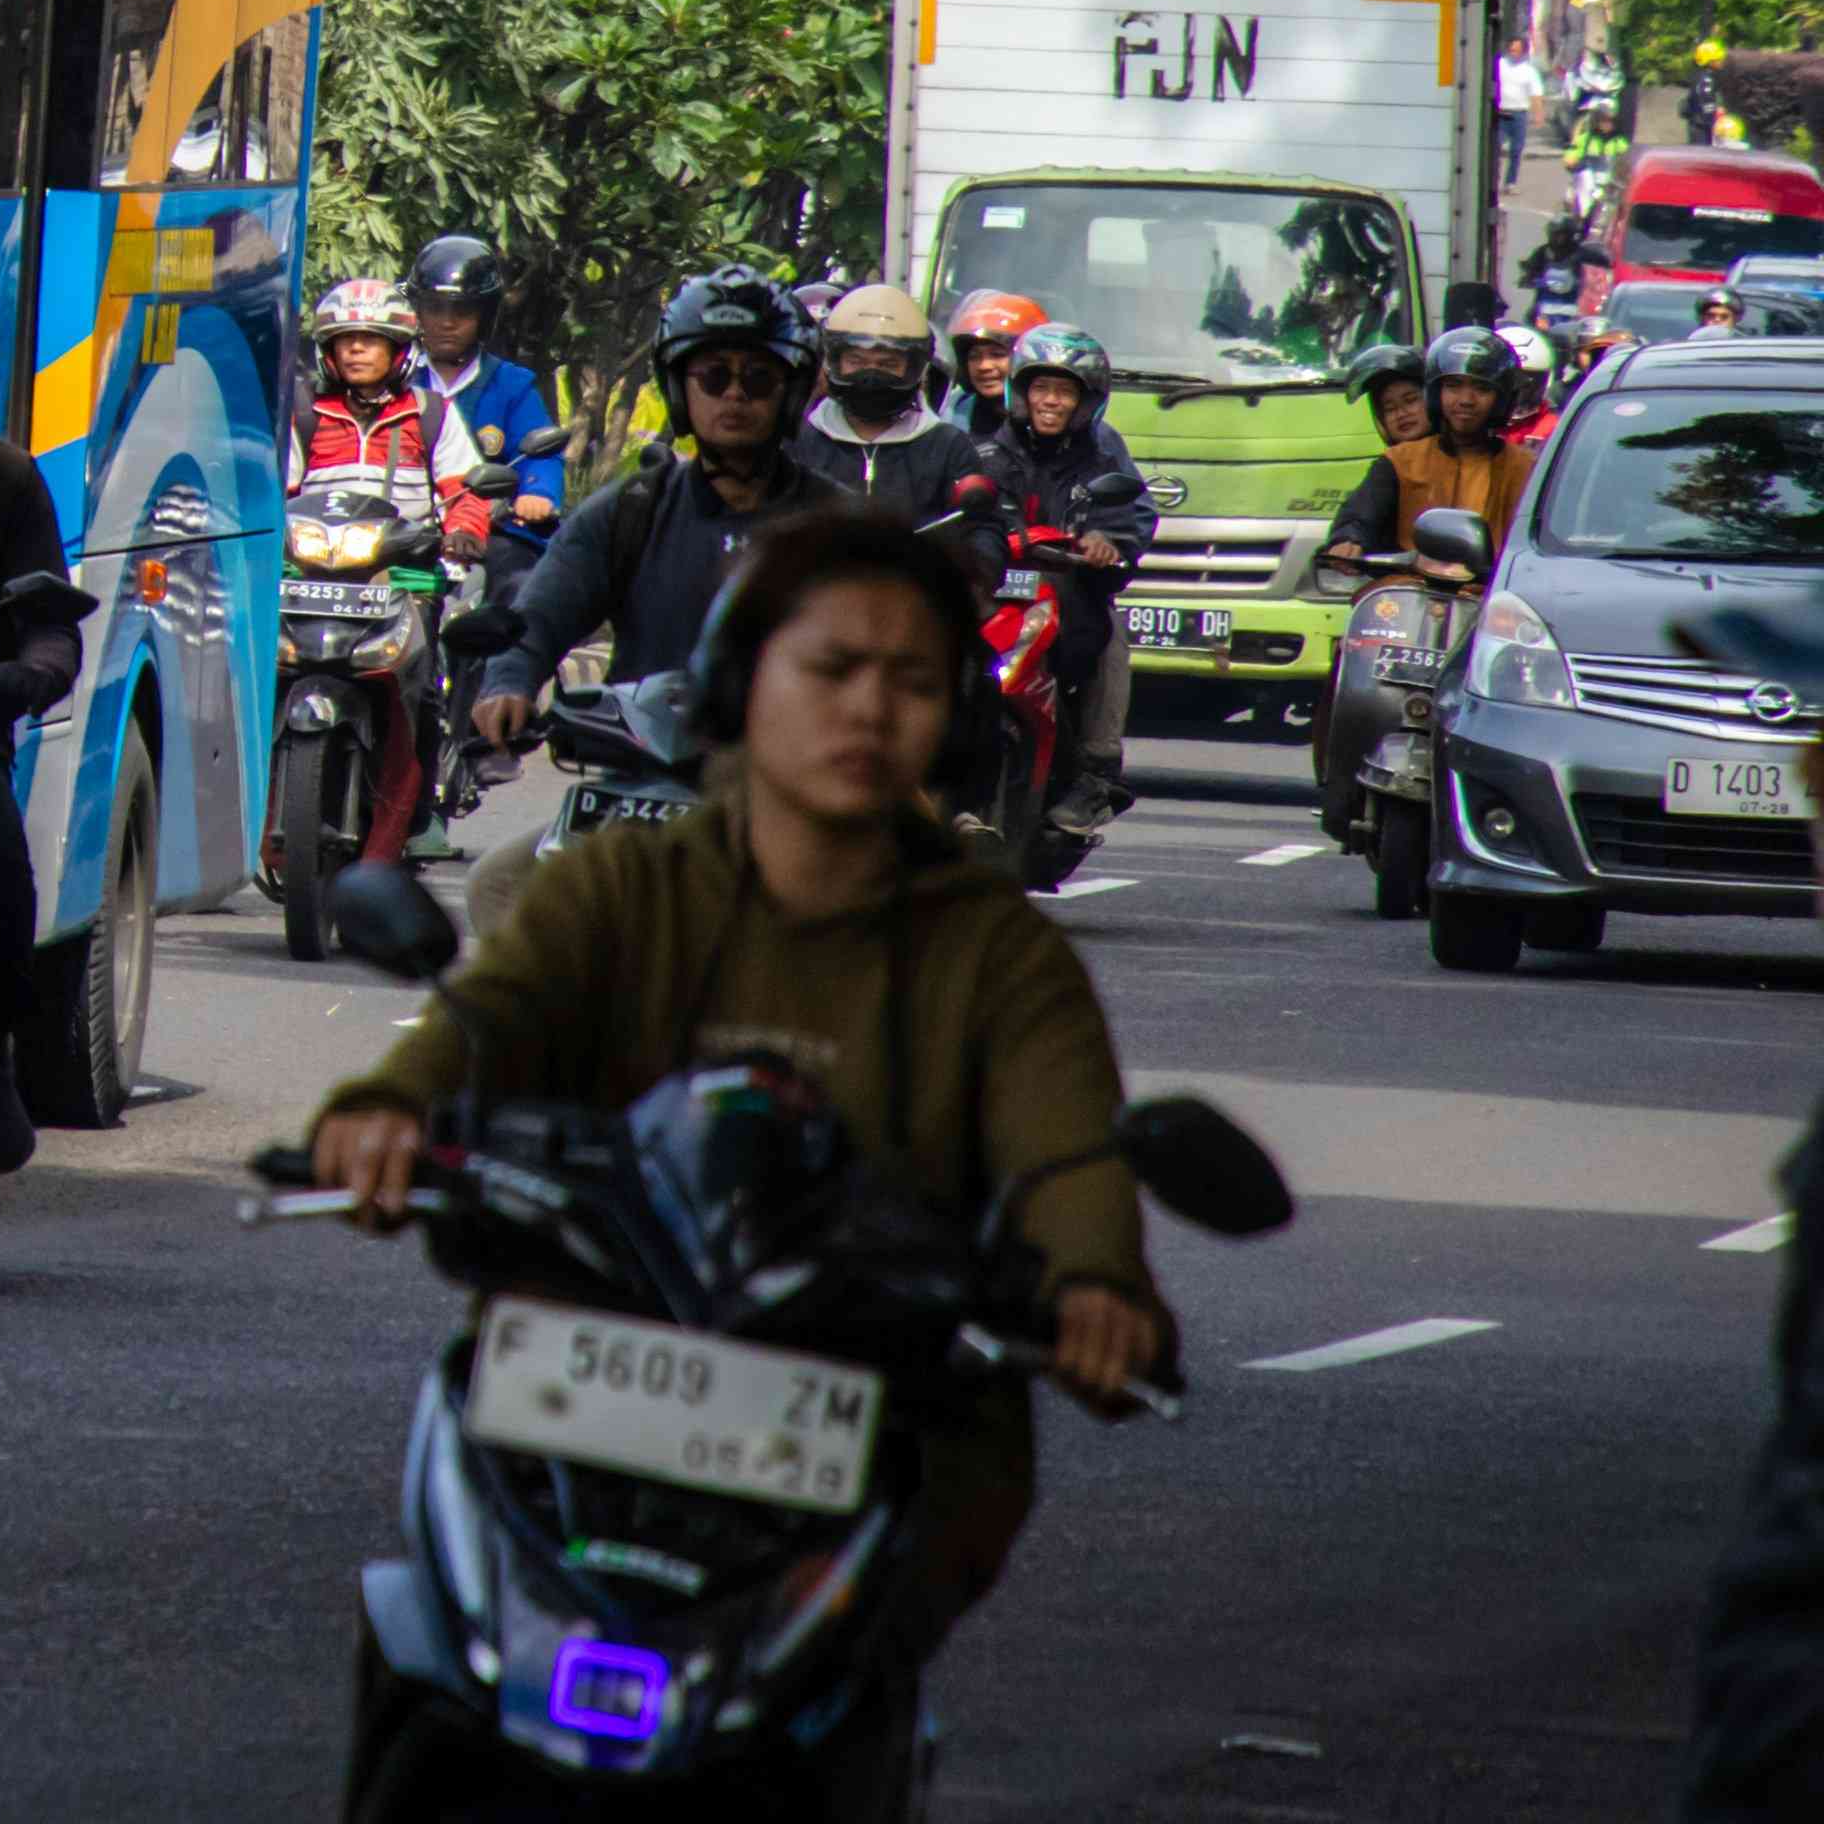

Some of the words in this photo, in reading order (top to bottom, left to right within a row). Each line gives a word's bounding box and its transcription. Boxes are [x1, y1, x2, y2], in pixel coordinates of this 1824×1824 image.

[299, 584, 345, 601] 5253
[1128, 607, 1180, 634] 8910
[1202, 611, 1230, 637] DH
[1673, 761, 1690, 793] D
[1713, 763, 1781, 797] 1403
[1739, 801, 1789, 814] 07-28
[493, 1316, 528, 1364] F
[568, 1324, 713, 1408] 5609
